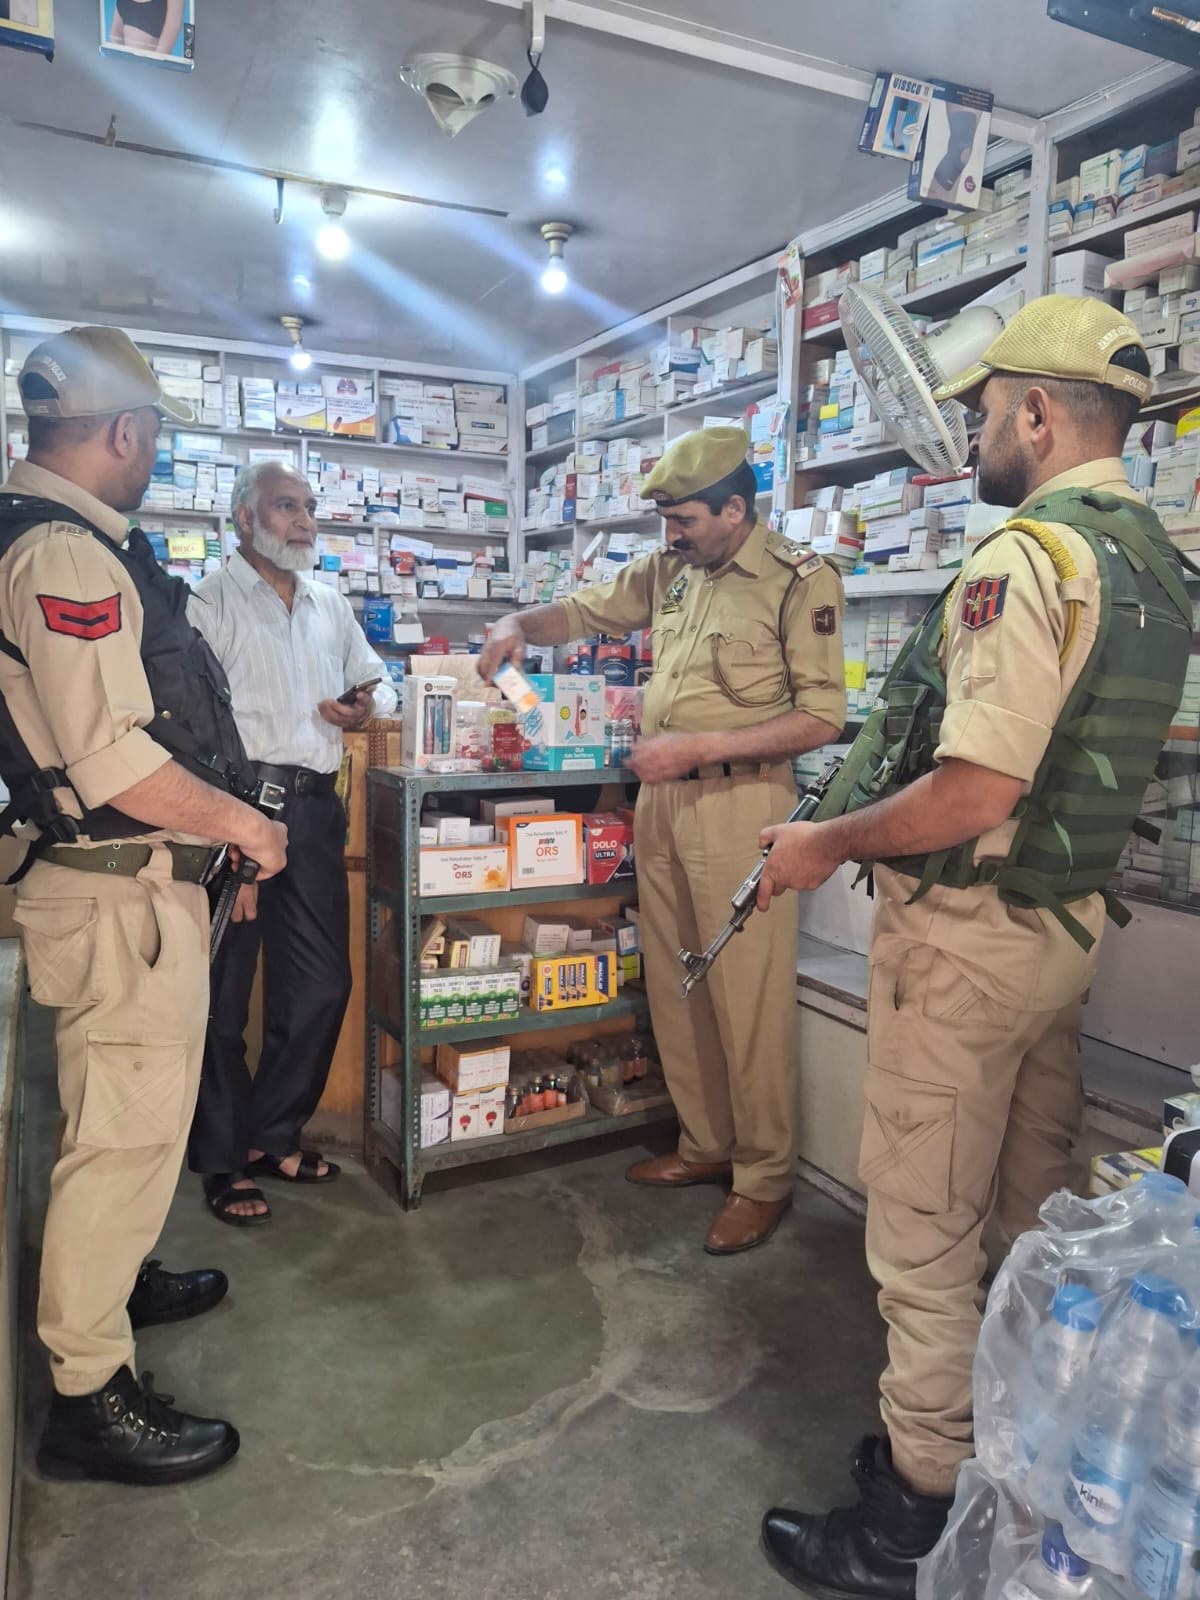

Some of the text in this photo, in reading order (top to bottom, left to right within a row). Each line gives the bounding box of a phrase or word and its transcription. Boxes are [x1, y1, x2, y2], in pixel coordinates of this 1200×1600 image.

[893, 77, 922, 96] VISSCO
[592, 840, 618, 849] DOLO
[536, 846, 559, 857] ORS
[595, 851, 615, 859] ULTRA
[454, 871, 473, 880] ORS
[1079, 1484, 1117, 1512] kinl
